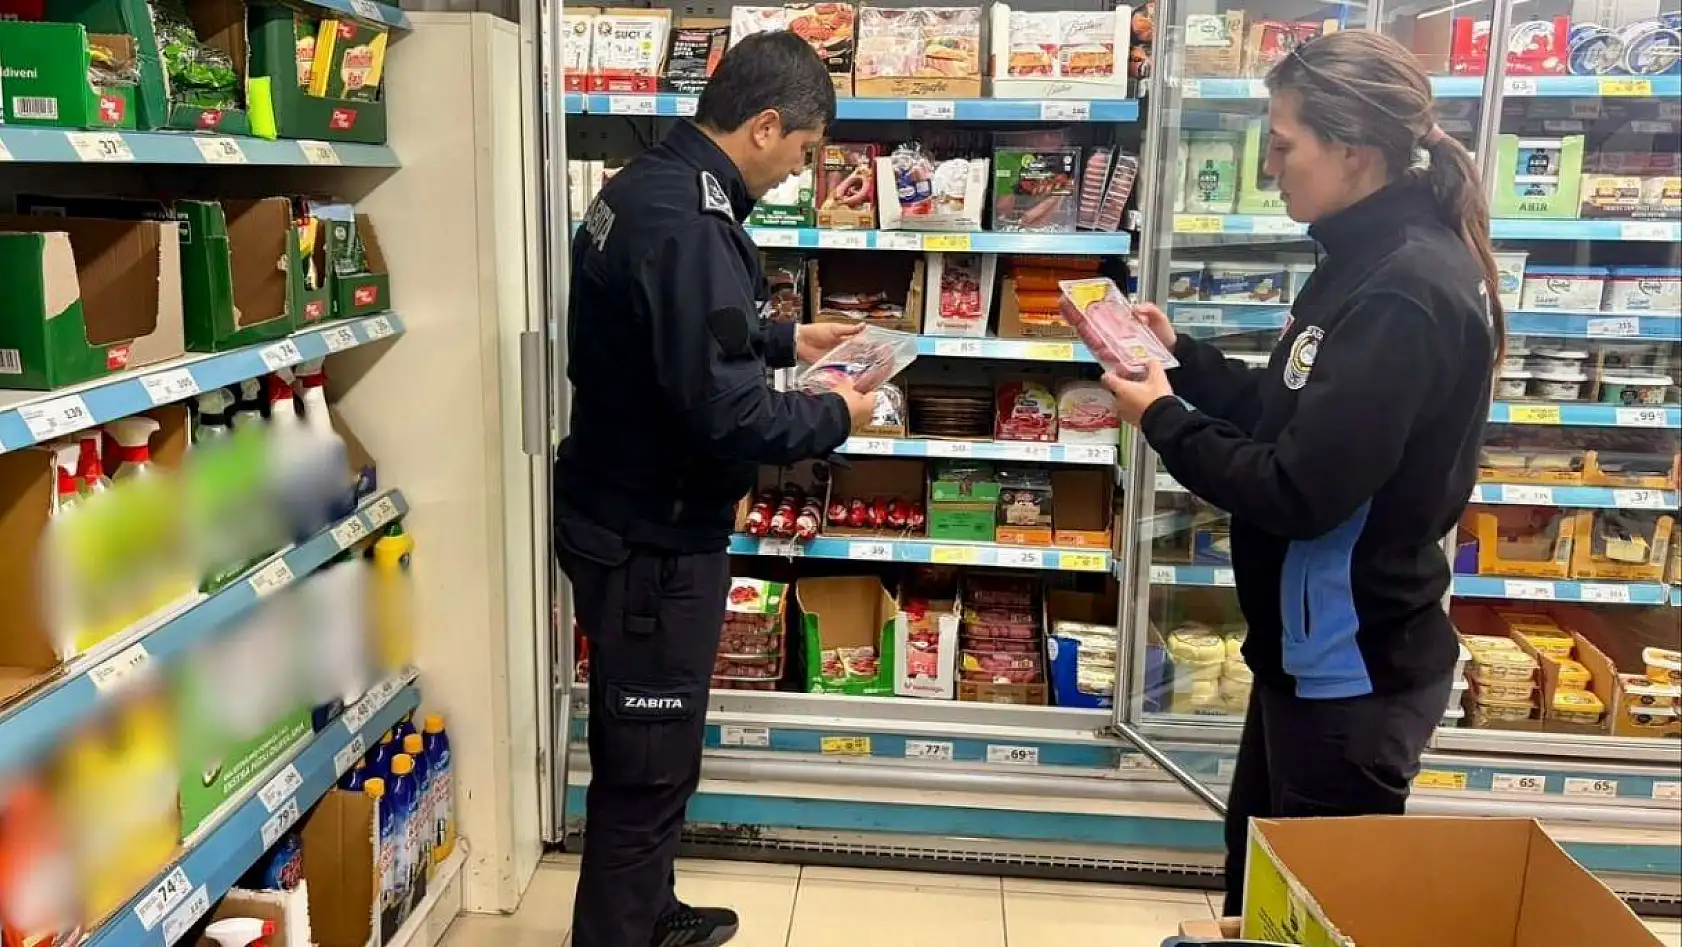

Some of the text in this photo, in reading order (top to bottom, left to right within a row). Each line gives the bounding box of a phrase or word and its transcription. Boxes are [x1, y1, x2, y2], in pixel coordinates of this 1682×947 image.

[99, 140, 117, 154] 37
[1639, 411, 1656, 421] 99
[1020, 552, 1035, 562] 25
[625, 697, 682, 708] ZABITA
[925, 744, 940, 754] 77
[1010, 749, 1026, 759] 69
[1518, 778, 1535, 788] 65
[1594, 781, 1610, 791] 65
[158, 879, 177, 901] 74
